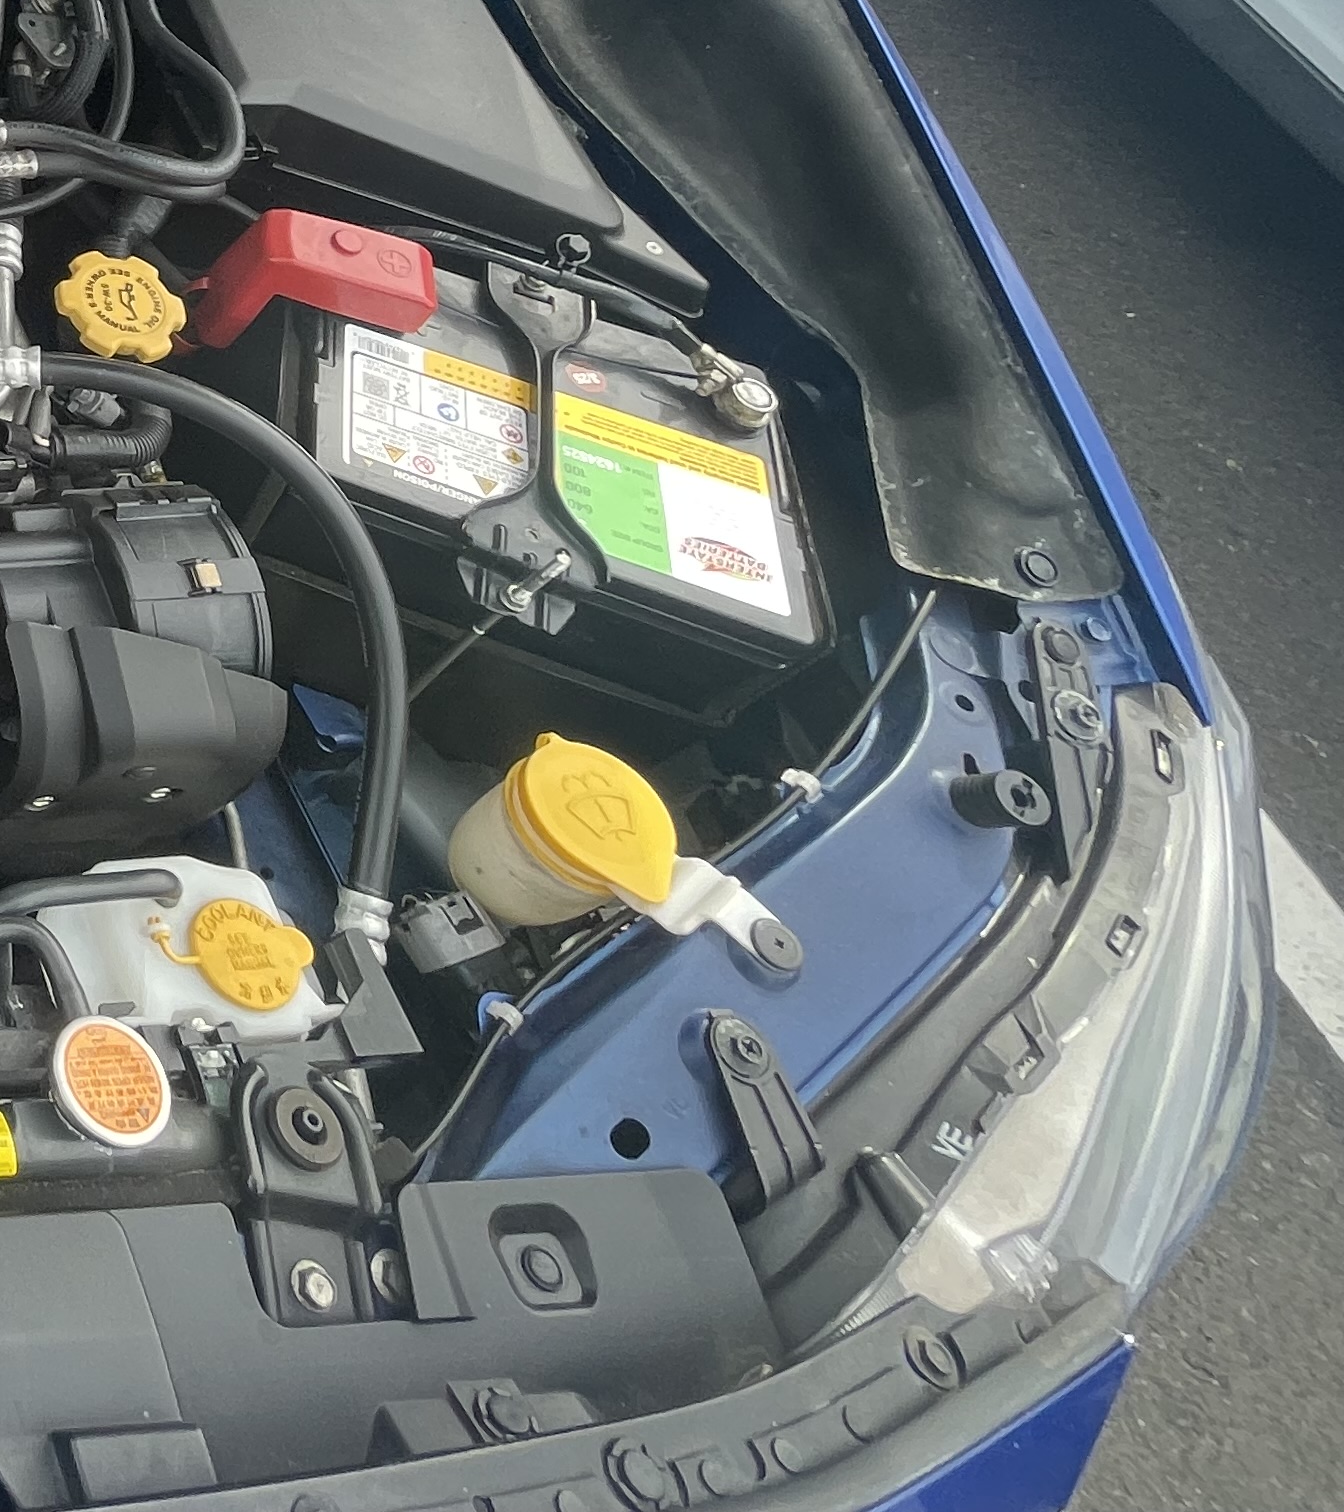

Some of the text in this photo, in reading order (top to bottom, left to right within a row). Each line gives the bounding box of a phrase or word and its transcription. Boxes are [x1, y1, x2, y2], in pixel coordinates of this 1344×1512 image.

[95, 310, 141, 333] MANUAL
[136, 276, 163, 329] ENGINE OIL
[391, 468, 481, 506] ANGER/POISON
[562, 462, 585, 478] 100
[676, 543, 771, 583] INTERSTATE
[682, 535, 767, 571] BATTERIES
[194, 903, 276, 941] COOLANT
[930, 1121, 974, 1161] VE
